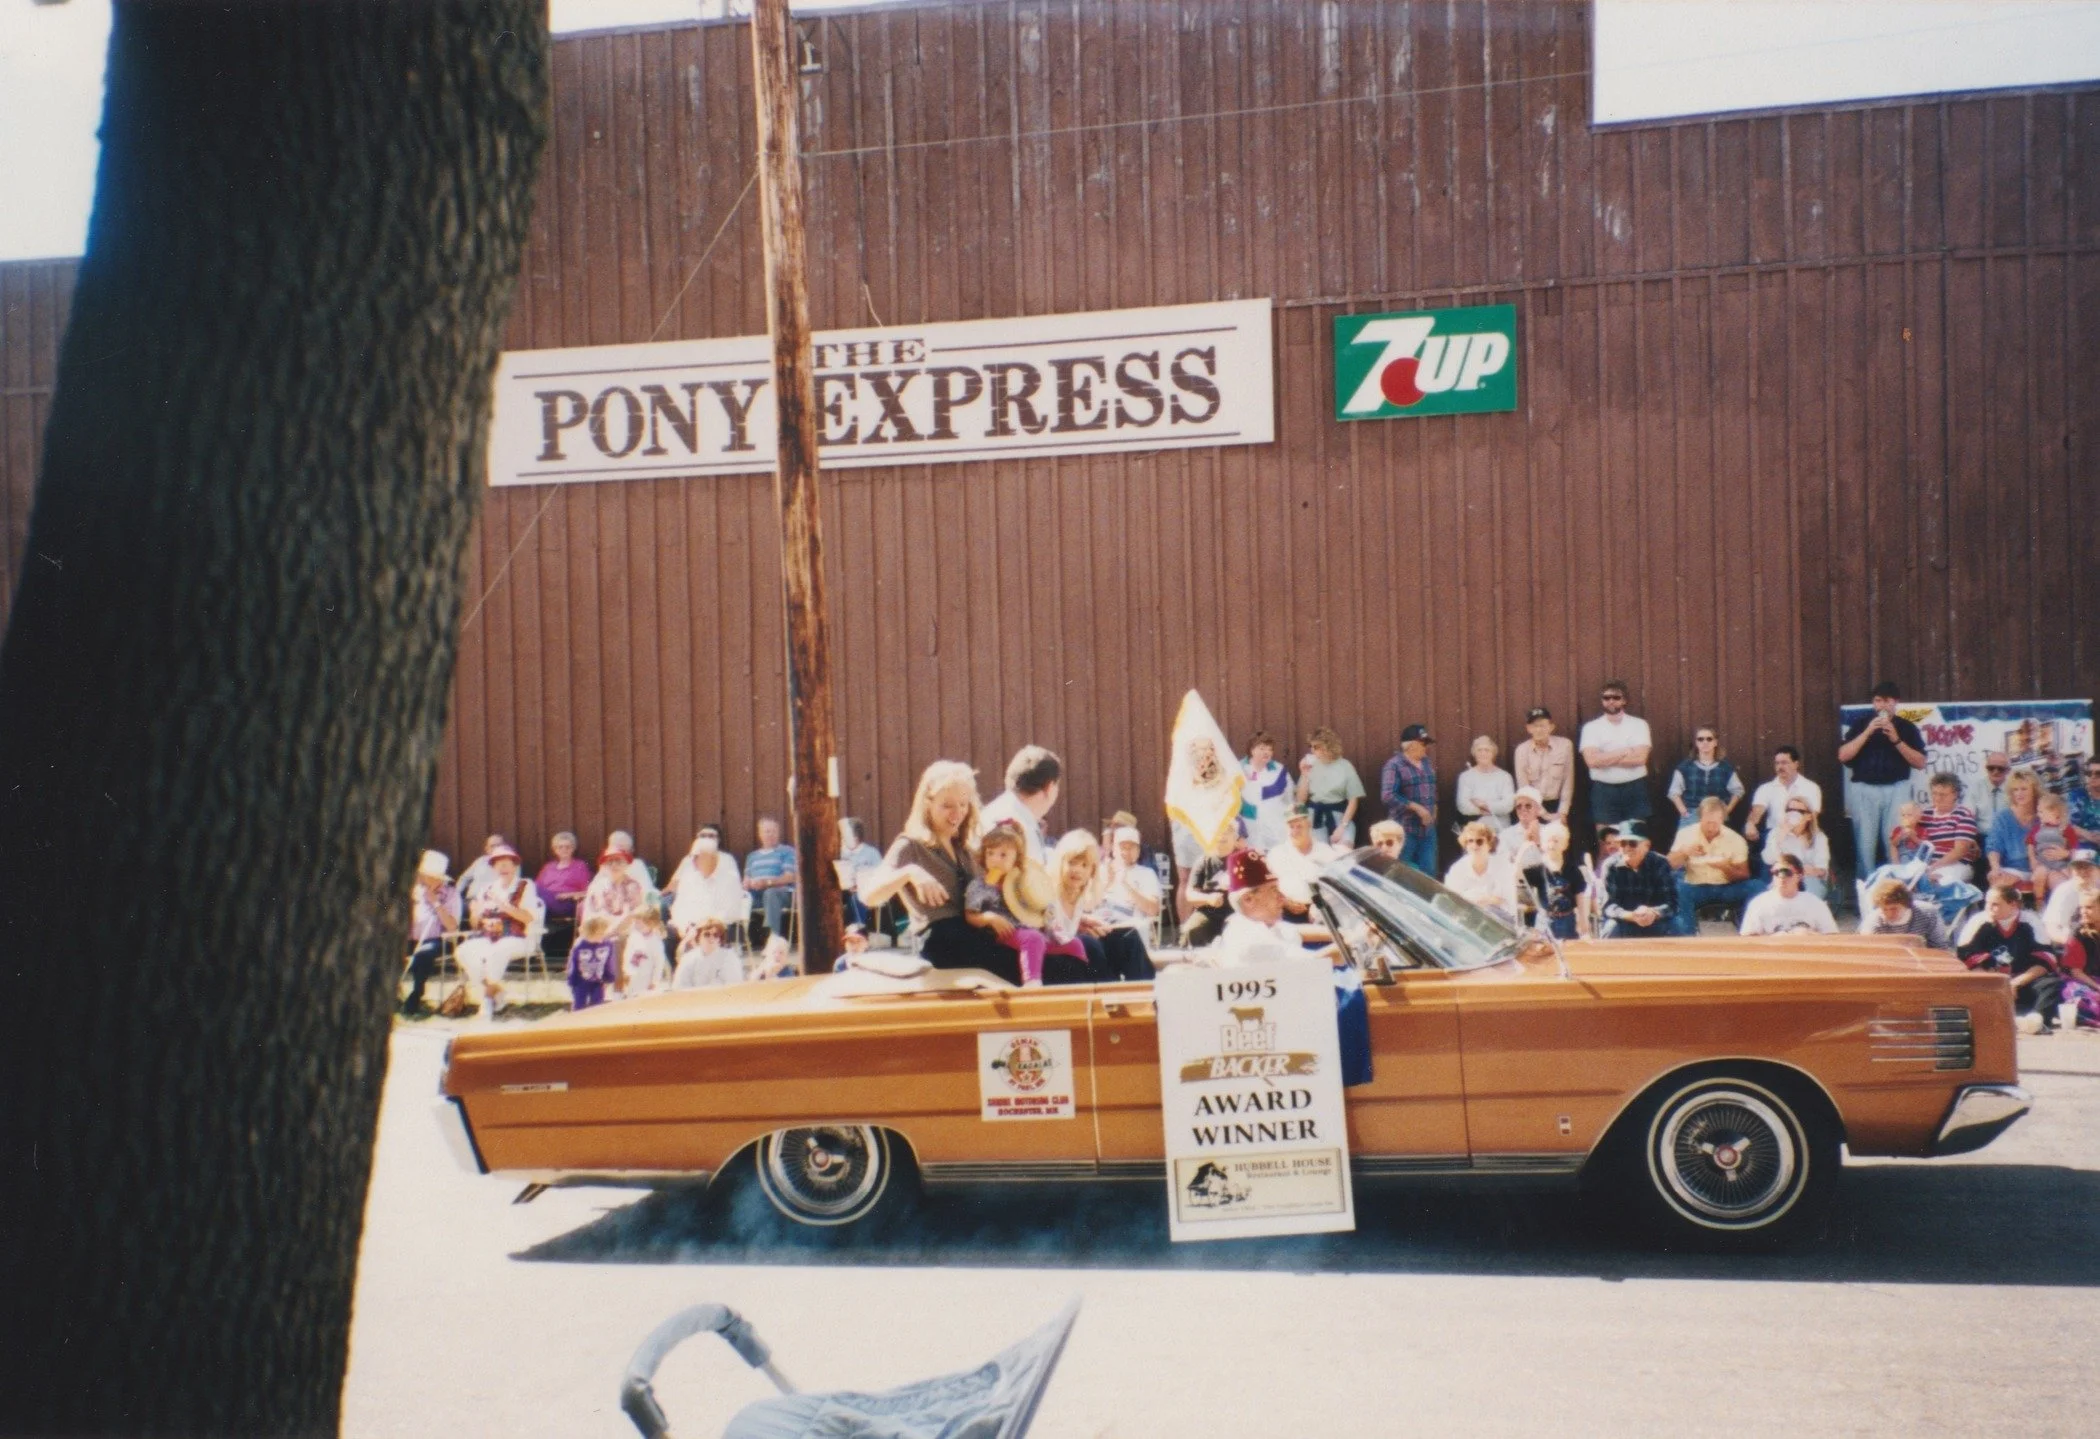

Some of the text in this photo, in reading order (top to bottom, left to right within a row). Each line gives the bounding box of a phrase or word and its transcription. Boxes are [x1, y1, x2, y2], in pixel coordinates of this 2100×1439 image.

[815, 338, 926, 368] THE
[534, 345, 1221, 462] PONY EXPRESS
[1216, 979, 1277, 1001] 1995
[1210, 1054, 1290, 1079] BACKER
[1194, 1089, 1312, 1117] AWARD
[1192, 1119, 1319, 1147] WINNER
[1234, 1157, 1332, 1172] HUBBELL HOUSE
